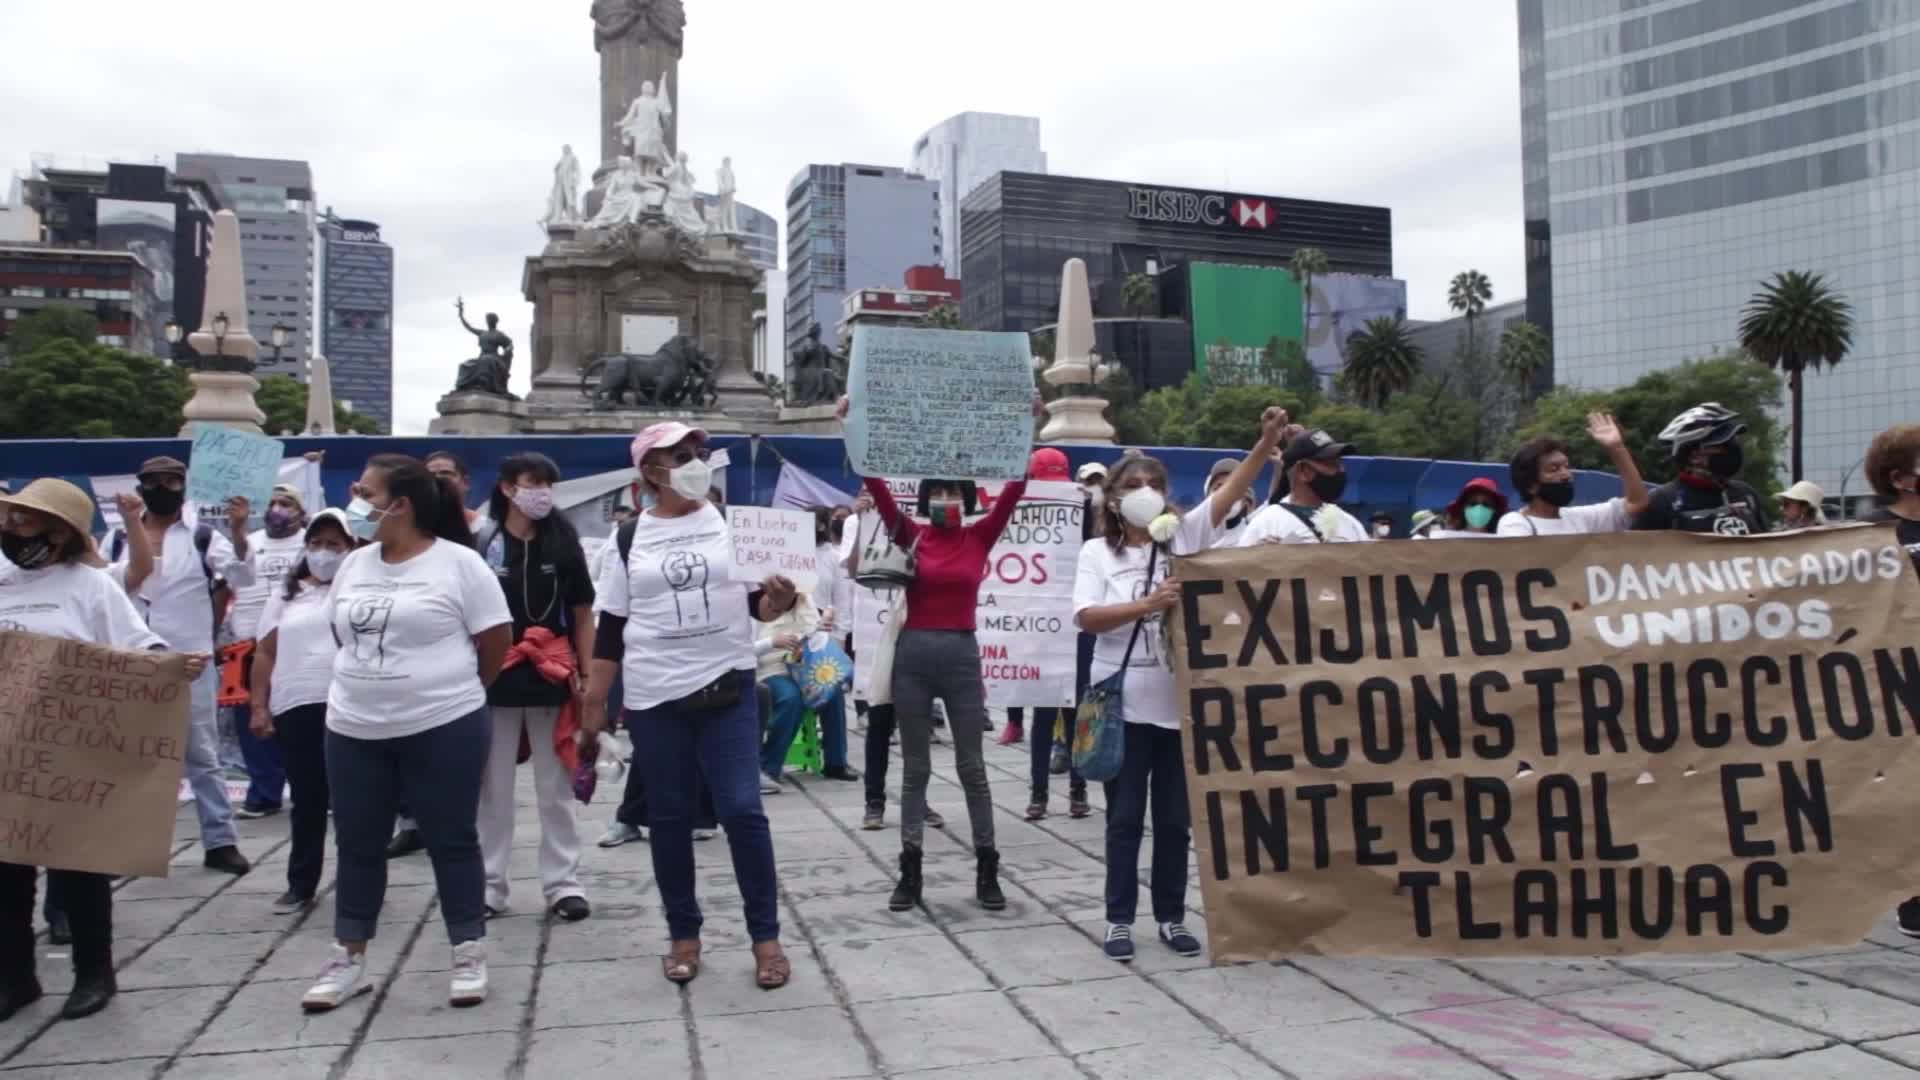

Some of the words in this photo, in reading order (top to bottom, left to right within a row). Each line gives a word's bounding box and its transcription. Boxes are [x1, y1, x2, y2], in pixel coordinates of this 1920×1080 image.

[1128, 187, 1226, 225] HSBC
[343, 230, 379, 241] BBVA
[999, 525, 1064, 545] ADOS
[1011, 507, 1080, 526] LAHUAC
[985, 615, 1062, 633] MEXICO
[1182, 567, 1571, 670] EXIJIMOS
[1586, 546, 1902, 606] DAMNIFICADOS
[1595, 600, 1833, 648] UNIDOS
[1190, 627, 1920, 775] RECONSTRUCCIÓN
[1206, 771, 1639, 880] INTEGRAL
[1720, 759, 1833, 857] EN
[1399, 861, 1790, 940] TLAHUAC
